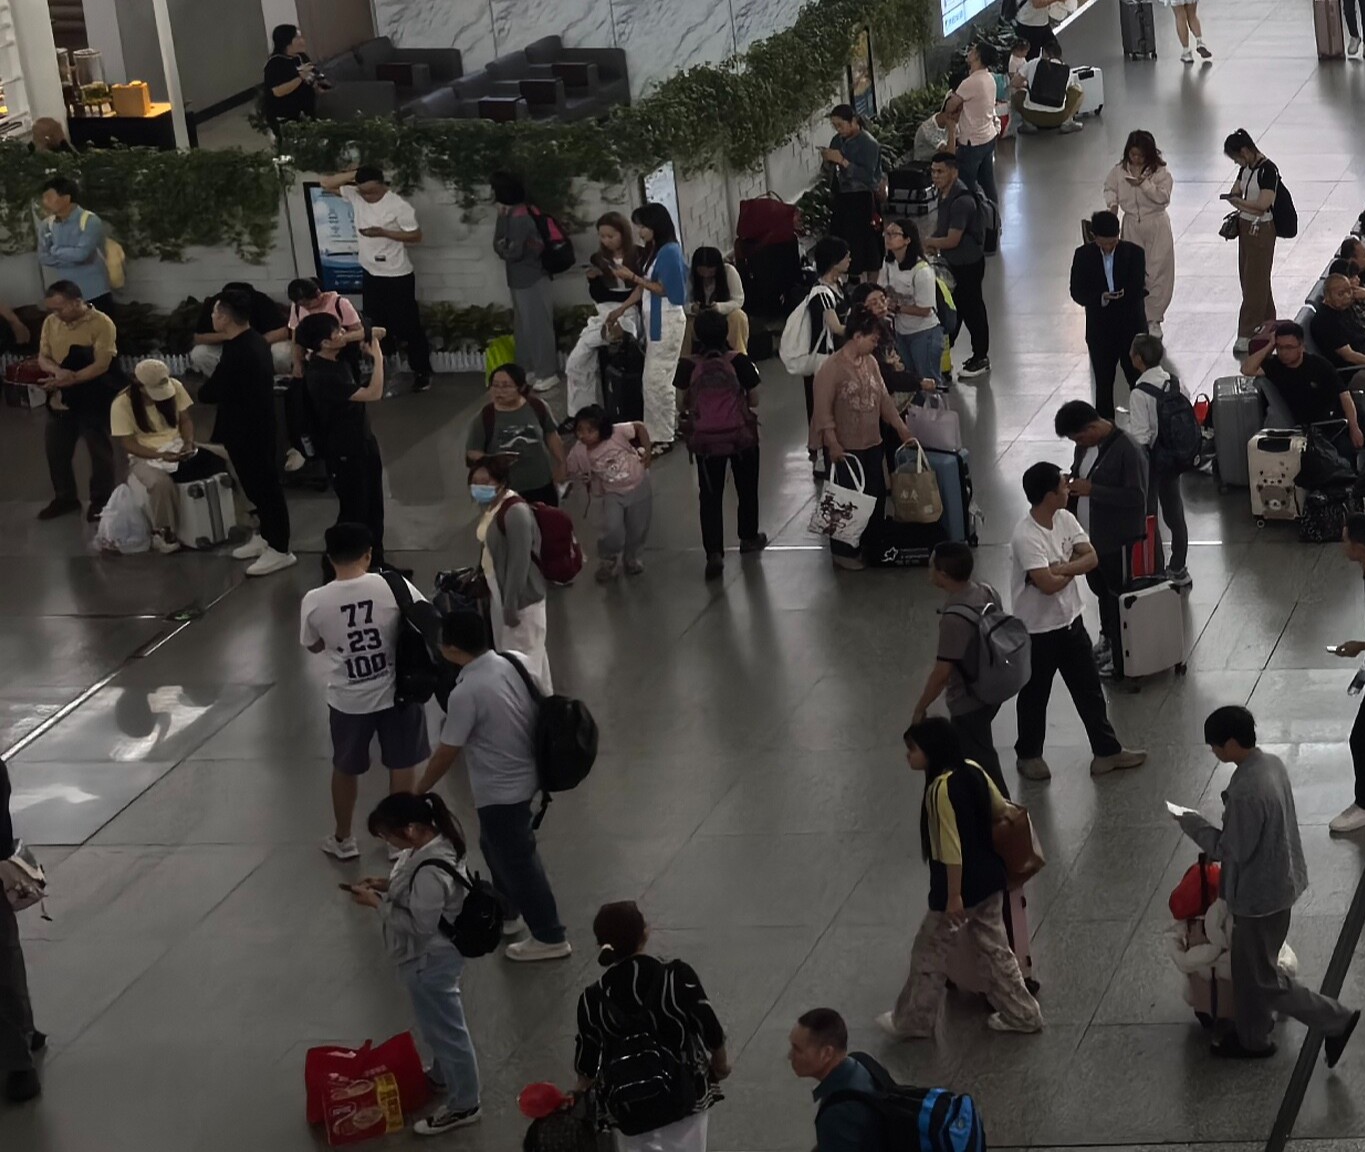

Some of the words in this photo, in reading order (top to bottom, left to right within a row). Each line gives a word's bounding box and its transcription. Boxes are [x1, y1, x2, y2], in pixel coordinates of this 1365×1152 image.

[341, 600, 373, 628] 77
[348, 628, 383, 654] 23
[346, 652, 387, 680] 100
